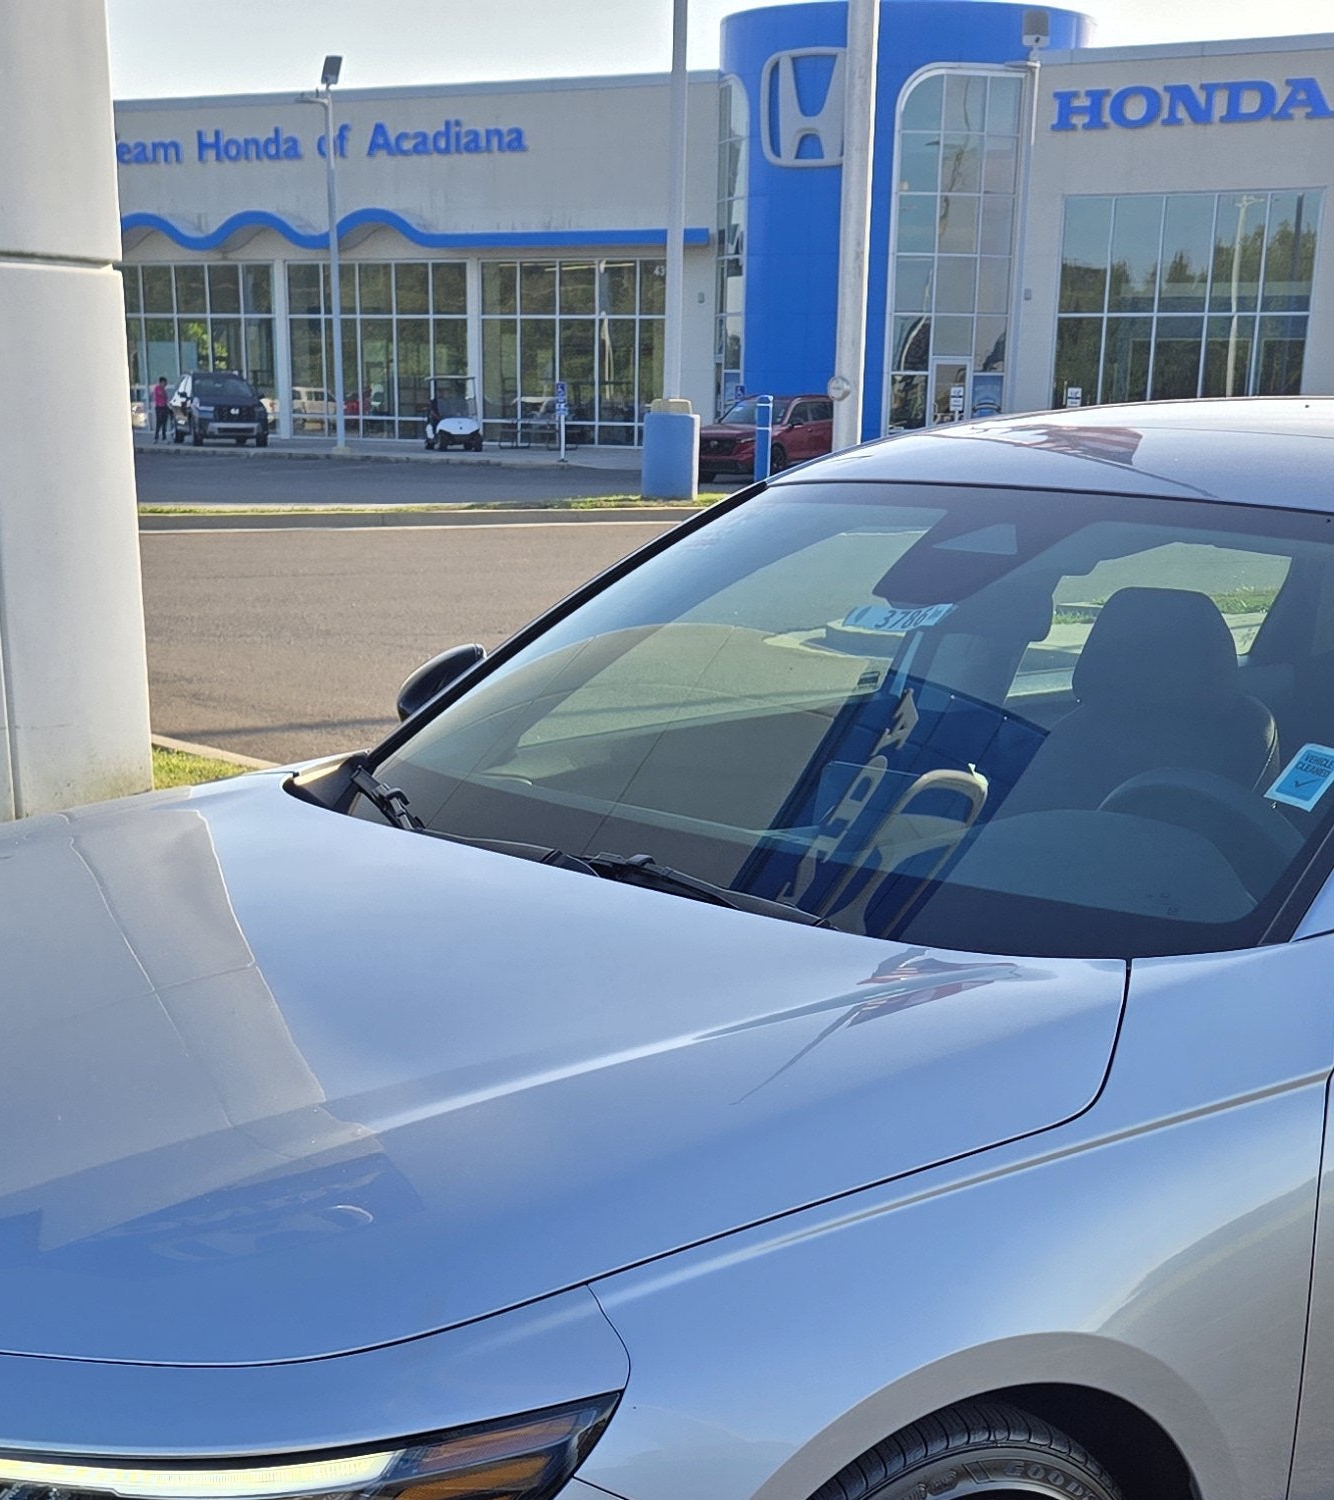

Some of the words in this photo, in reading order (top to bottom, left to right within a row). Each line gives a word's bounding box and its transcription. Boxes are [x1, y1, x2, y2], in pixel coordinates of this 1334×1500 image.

[116, 139, 182, 165] eam
[196, 126, 302, 162] Honda
[317, 123, 352, 158] of
[366, 119, 529, 158] Acadiana
[874, 606, 933, 629] 3786
